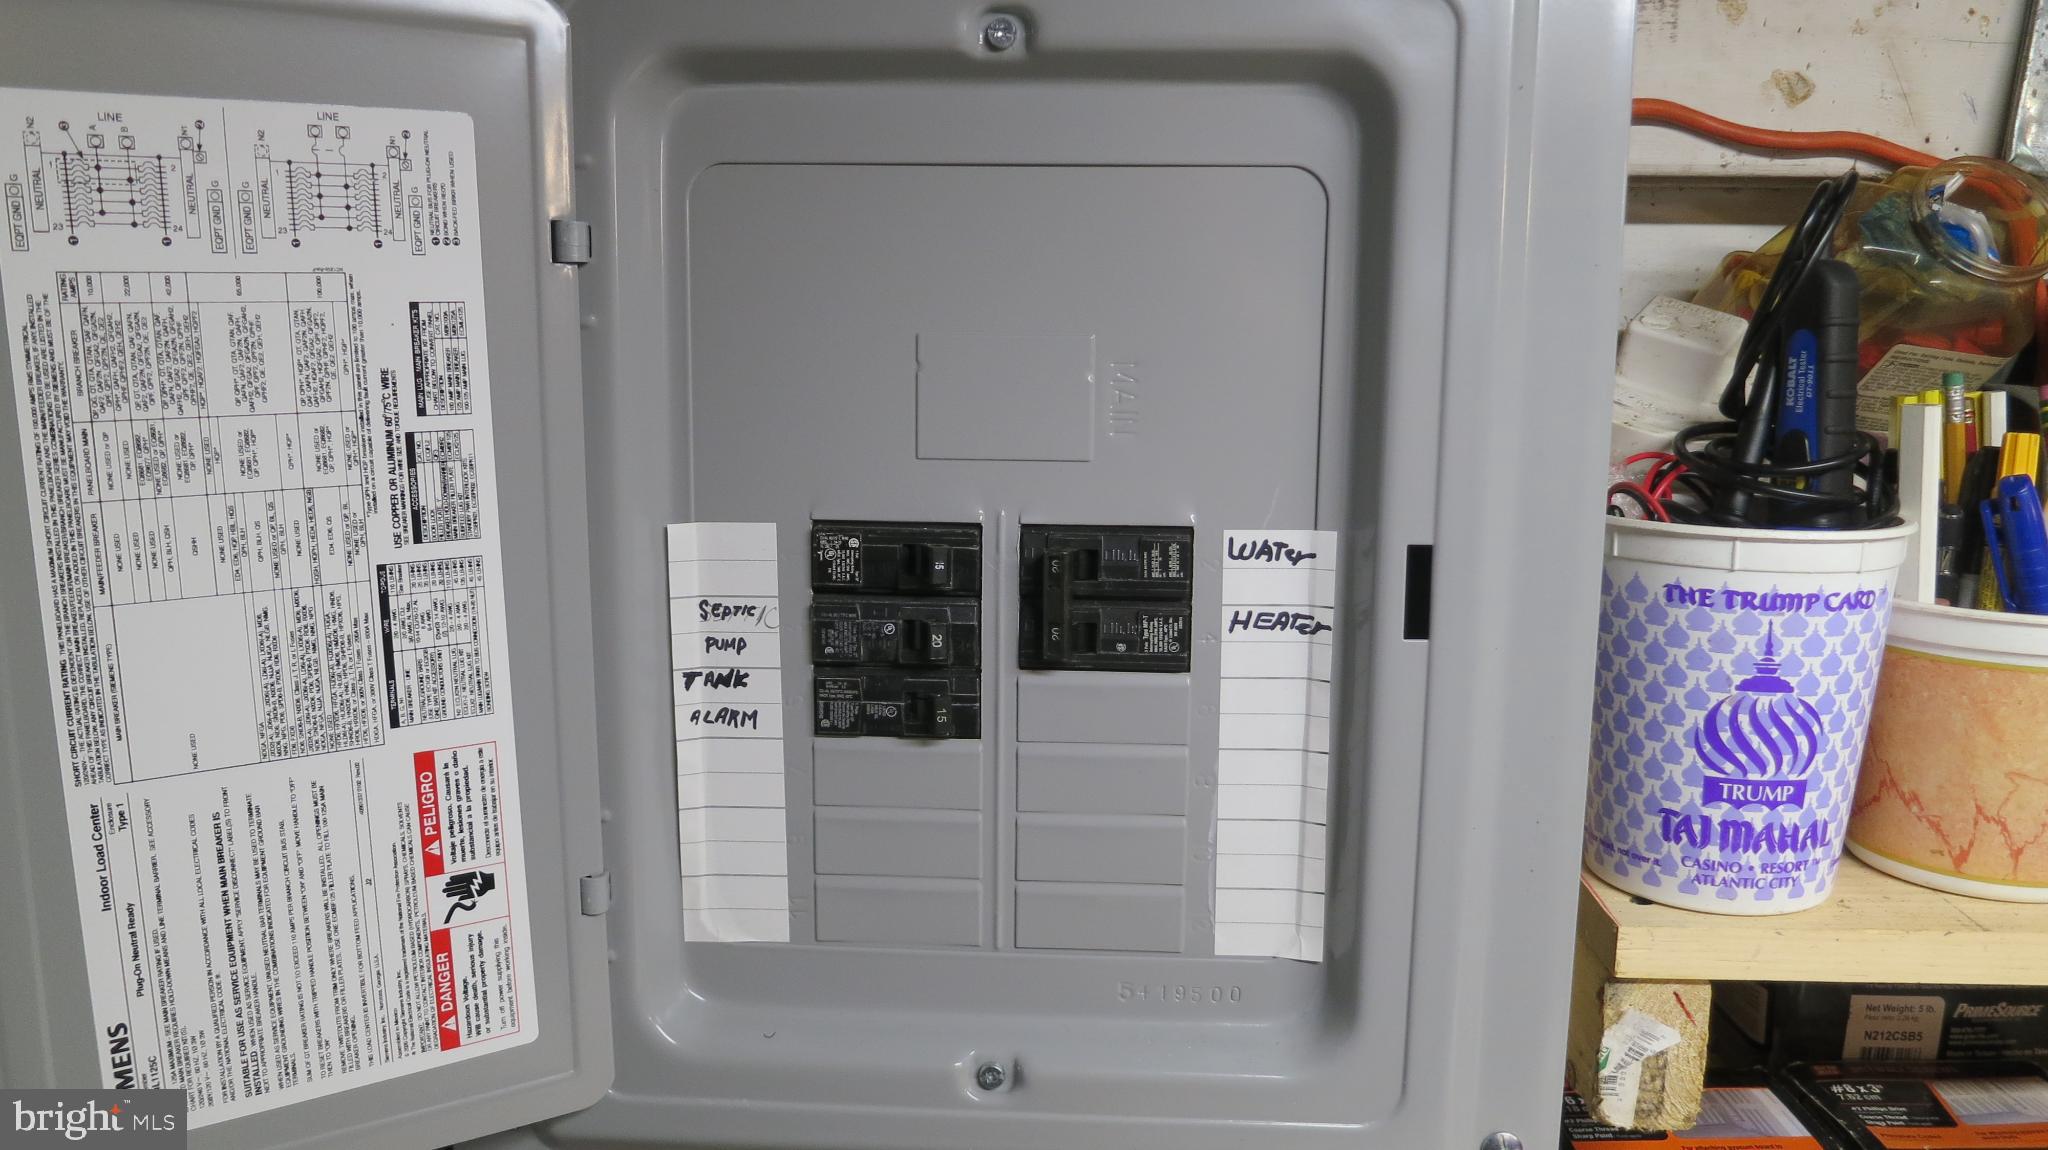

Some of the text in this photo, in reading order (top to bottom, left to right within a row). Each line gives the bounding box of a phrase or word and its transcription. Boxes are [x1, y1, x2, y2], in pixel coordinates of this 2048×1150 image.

[26, 116, 34, 128] N2
[98, 112, 123, 122] LINE
[317, 112, 339, 121] LINE
[258, 129, 265, 141] N2
[32, 169, 42, 210] NEUTRAL
[186, 174, 195, 215] NEUTRAL
[263, 178, 272, 219] NEUTRAL
[394, 181, 403, 219] NEUTRAL
[13, 200, 25, 248] EQPT GND
[211, 204, 224, 250] EQPT GND
[242, 204, 254, 250] EQPT GND
[413, 209, 423, 252] EQPT GND
[59, 273, 69, 301] RATING
[68, 277, 77, 298] AMPS
[69, 329, 84, 396] BRANCH BREAKER
[379, 367, 390, 390] WIRE
[1785, 357, 1797, 406] KOBALT
[1795, 350, 1807, 413] Electrical Tester
[80, 427, 95, 496] PANELBOARD MAIN
[384, 428, 397, 475] ALUMINUM
[388, 477, 398, 491] OR
[389, 492, 401, 529] COPPER
[89, 512, 106, 595] MAIN/FEEDER BREAKER
[392, 531, 405, 549] USE
[1663, 583, 1876, 612] THE TRUMP CARD
[705, 636, 747, 655] PUMP
[931, 634, 943, 648] 20
[682, 669, 749, 690] TANK
[58, 658, 82, 787] SHORT CIRCUIT CURRENT RATING
[690, 708, 758, 729] ALARM
[937, 708, 948, 723] 15
[441, 761, 449, 769] la
[417, 770, 438, 835] PELIGRO
[454, 777, 462, 802] graves
[1720, 783, 1794, 802] TRUMP
[116, 809, 128, 830] Type
[446, 804, 456, 838] peligroso.
[456, 803, 464, 834] lesiones
[464, 804, 472, 812] la
[466, 820, 476, 860] substancial
[1657, 807, 1712, 850] TAJ
[1718, 818, 1830, 854] MAHAL
[88, 803, 112, 911] Indoor Load Center
[448, 840, 458, 864] Voltaje
[1632, 853, 1651, 863] over
[1681, 856, 1742, 873] CASINO
[1761, 860, 1808, 874] RESORT
[1691, 874, 1800, 890] ATLANTIC CITY
[124, 902, 145, 997] Plug-On Neutral Ready
[211, 811, 253, 1098] SUITABLE FOR USE AS SERVICE EQUIPMENT WHEN MAIN BREAKER IS
[467, 933, 475, 952] injury
[469, 953, 477, 978] serious
[479, 959, 487, 987] property
[434, 951, 454, 1012] DANGER
[463, 1003, 473, 1038] Hazardous
[473, 1002, 481, 1022] cause
[481, 989, 490, 1024] substantial
[1865, 1003, 1880, 1012] Net
[1882, 1004, 1914, 1014] Weight:
[1864, 1030, 1922, 1041] N212CSB5
[106, 1022, 135, 1090] MENS
[148, 1055, 160, 1089] L1125C
[249, 1050, 262, 1096] INSTALLED
